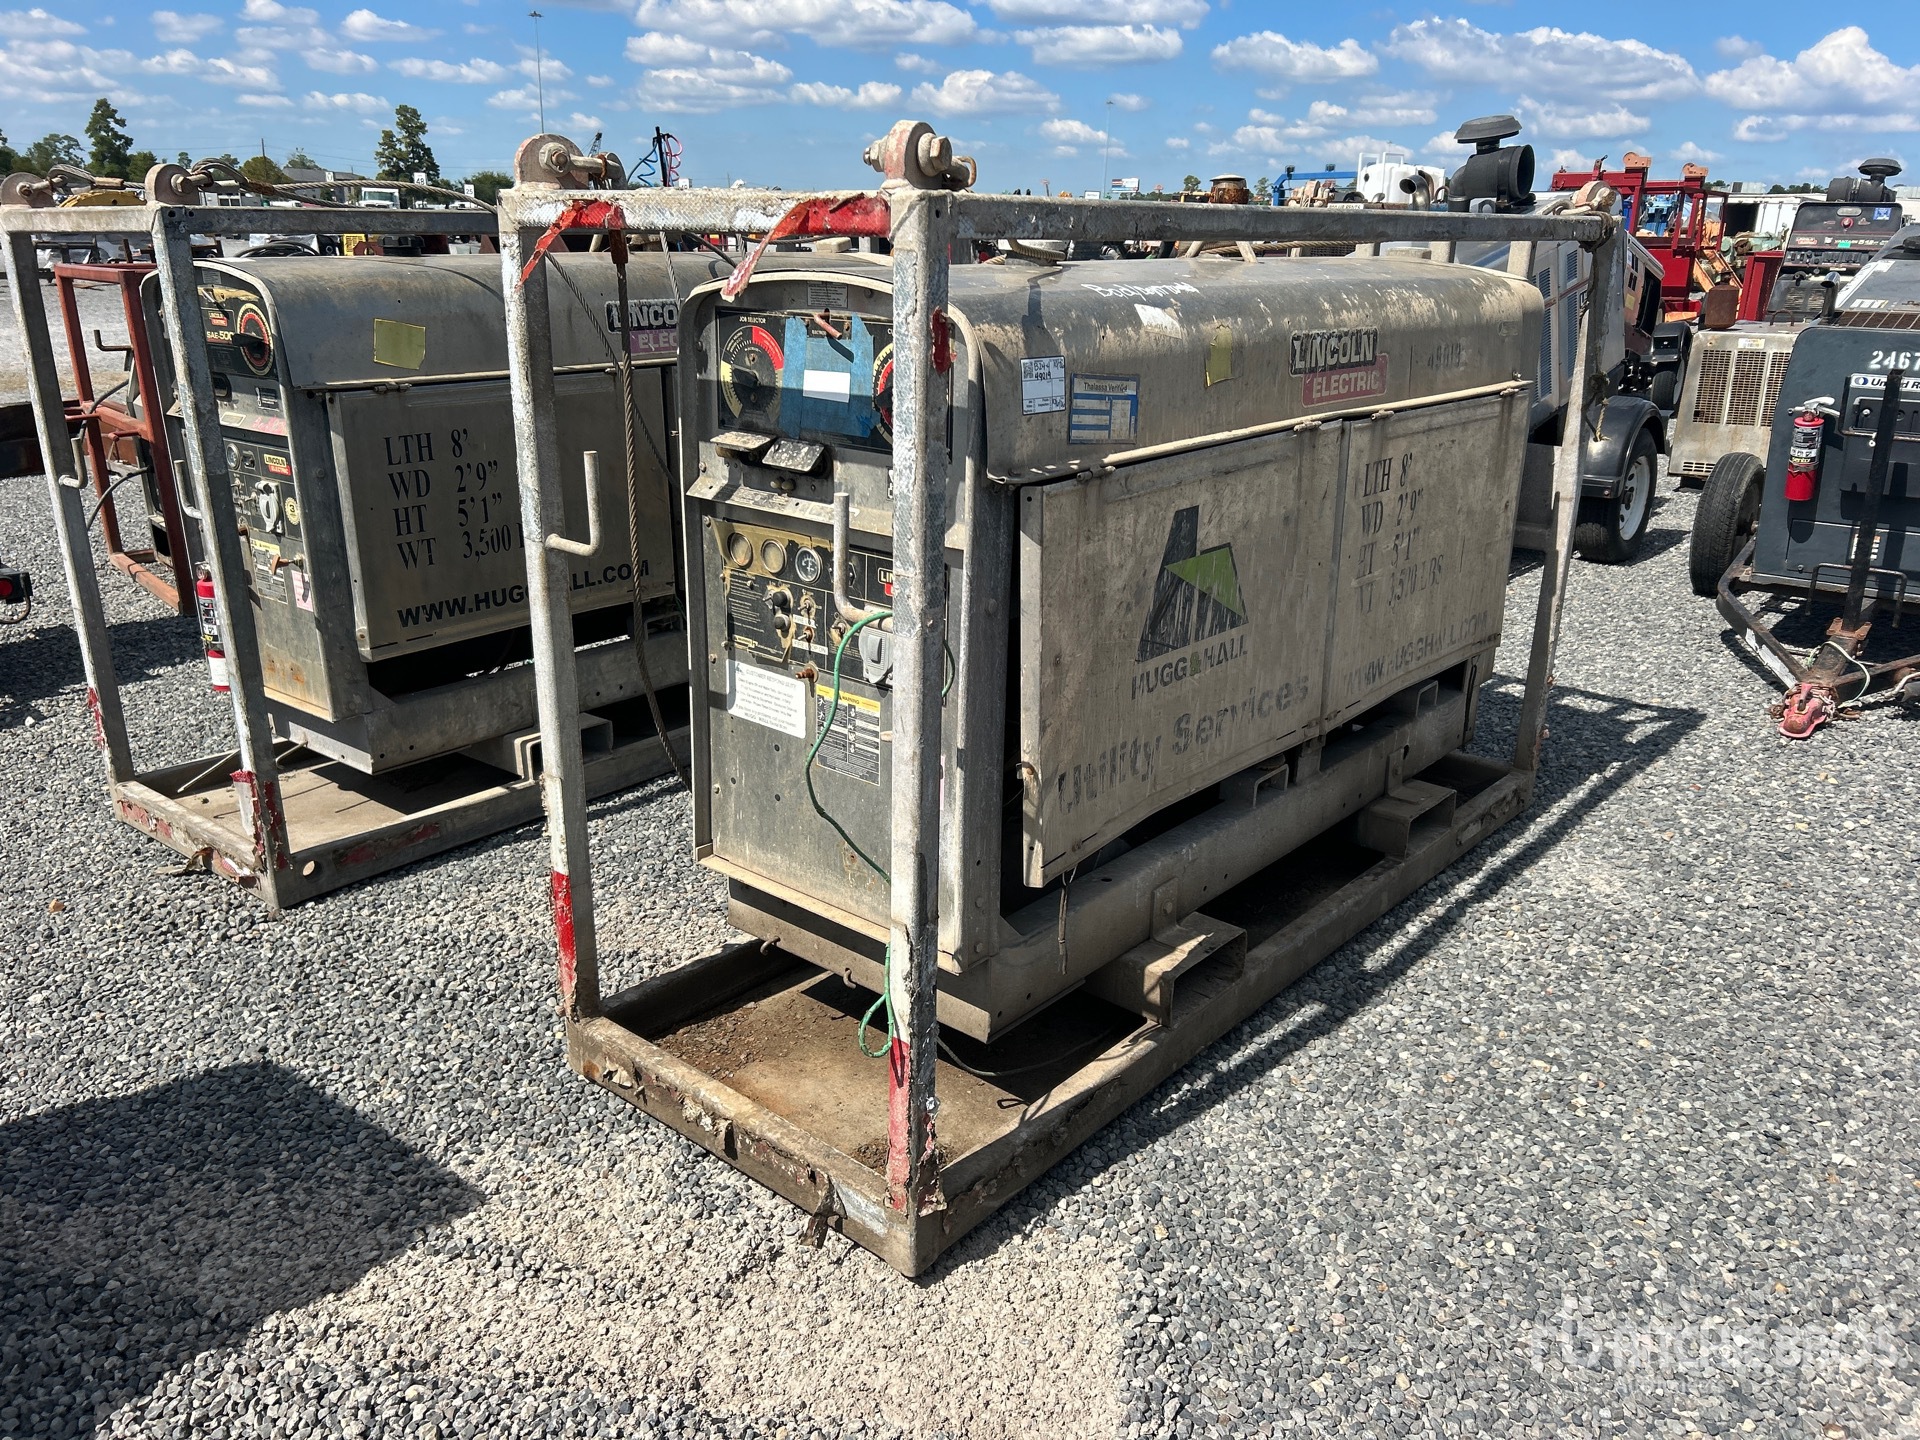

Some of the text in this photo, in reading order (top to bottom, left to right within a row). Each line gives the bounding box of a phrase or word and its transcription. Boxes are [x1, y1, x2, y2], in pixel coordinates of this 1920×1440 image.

[416, 178, 425, 186] 48
[1293, 333, 1374, 369] LINCOLN
[1312, 370, 1380, 399] ELECTRIC
[384, 432, 436, 466] LTH
[387, 469, 431, 500] WD
[1362, 457, 1394, 497] LTH
[392, 504, 428, 536] HT
[1361, 500, 1384, 537] WD
[397, 537, 436, 571] WT
[461, 524, 512, 563] 3,500
[1057, 675, 1309, 815] Utility Services
